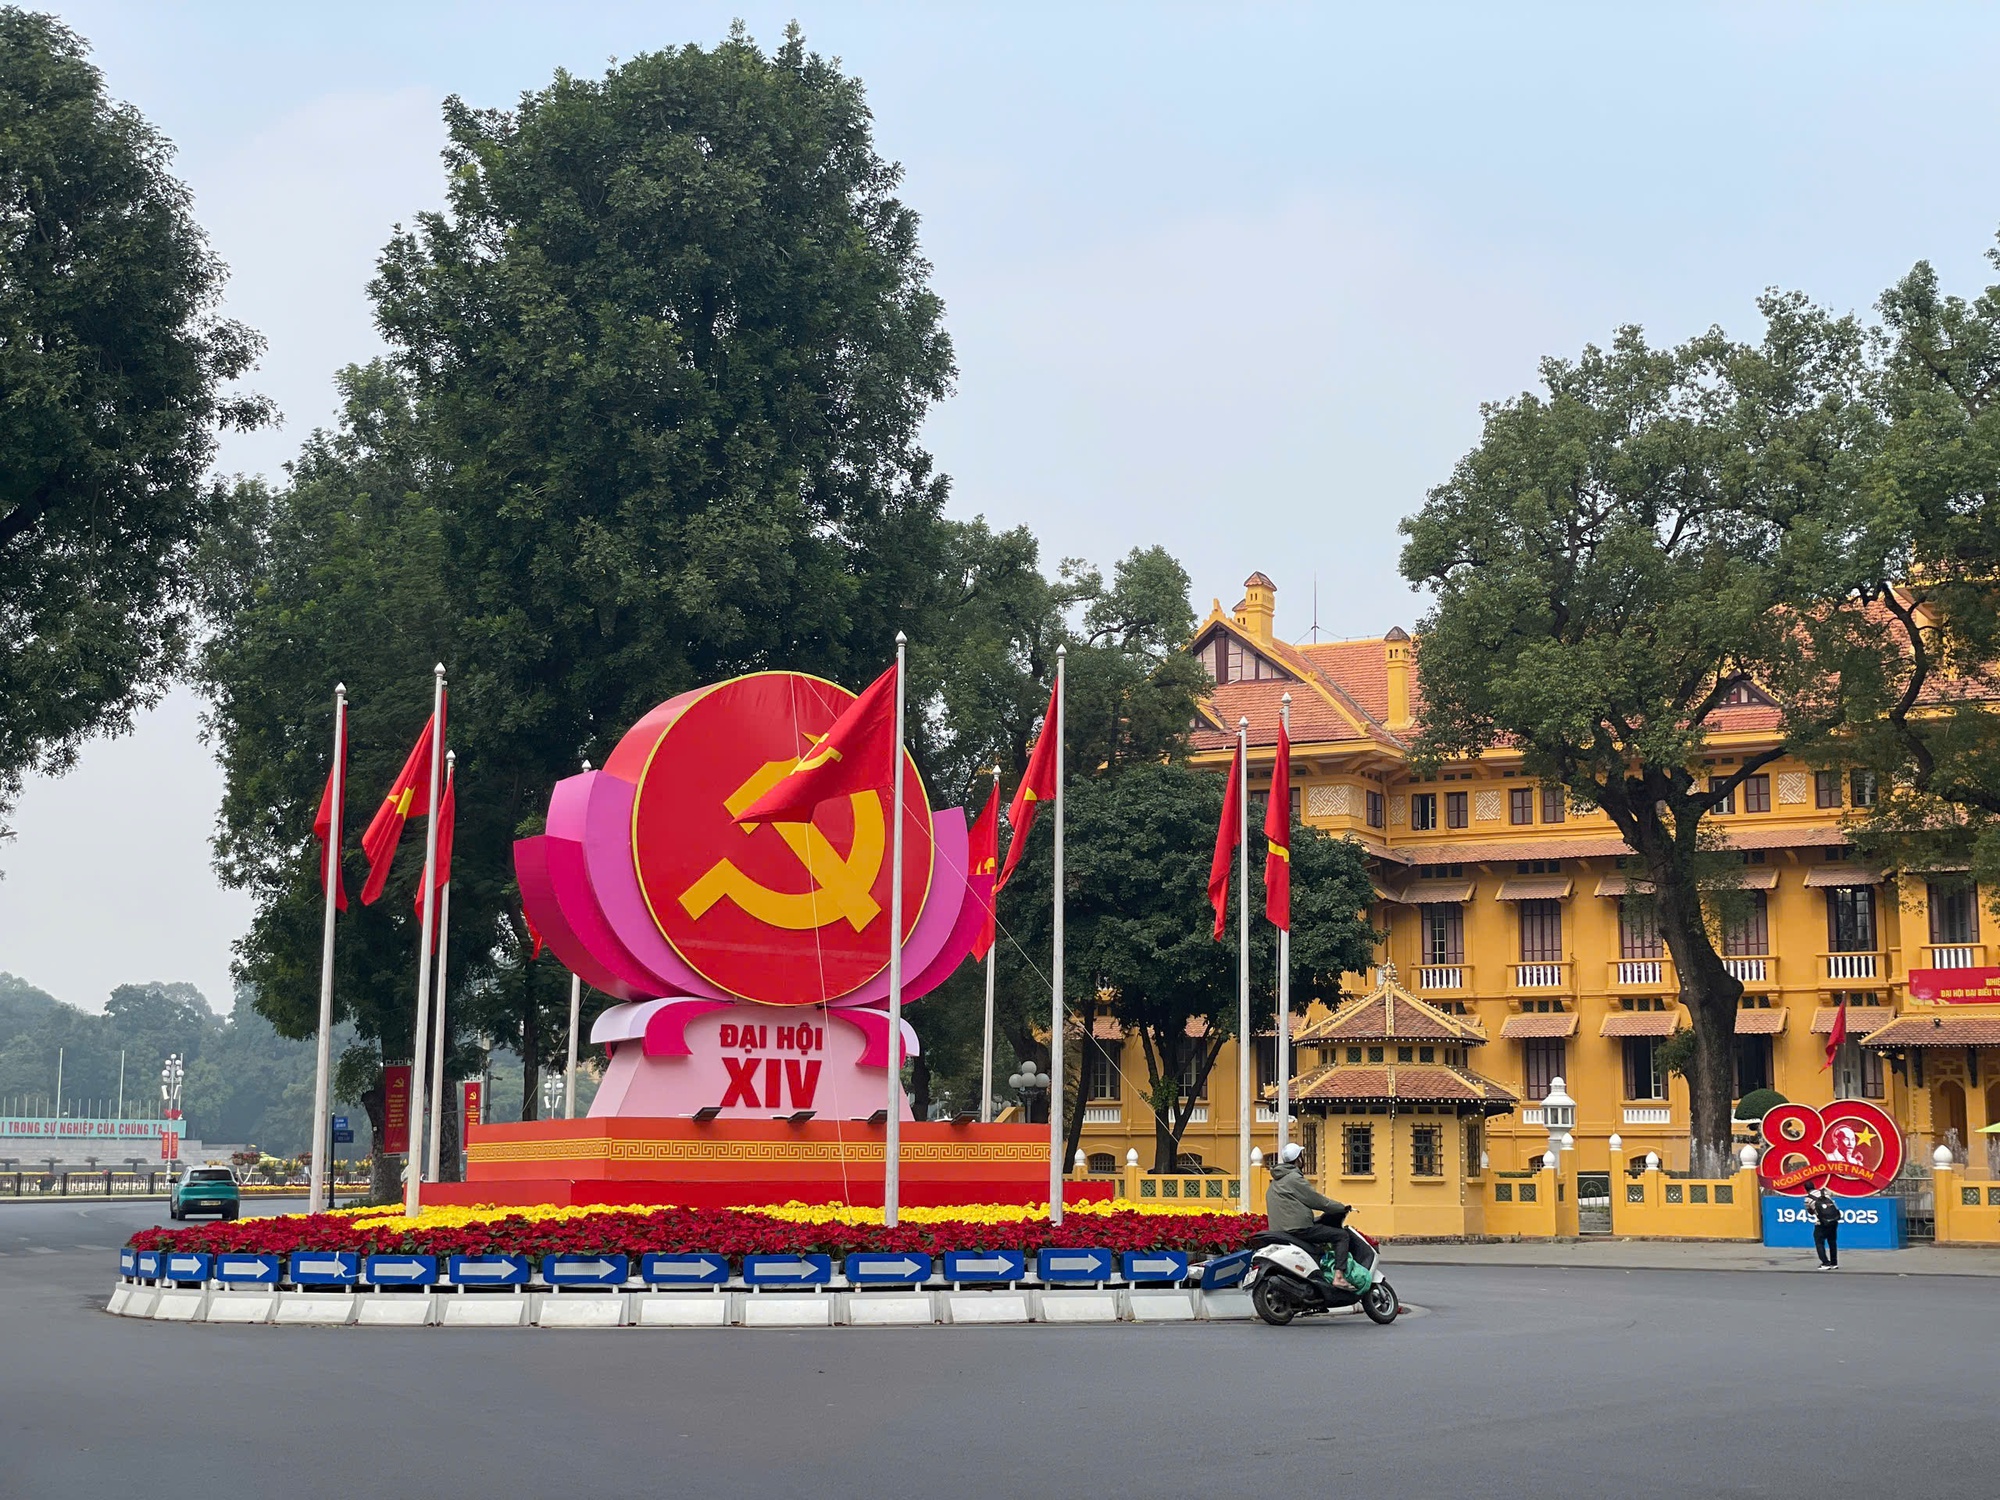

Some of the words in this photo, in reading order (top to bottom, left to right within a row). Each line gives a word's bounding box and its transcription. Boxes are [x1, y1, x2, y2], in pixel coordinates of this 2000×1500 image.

[719, 1024, 767, 1054] ĐẠI
[776, 1022, 823, 1055] HỘI
[719, 1057, 822, 1109] XIV
[9, 1121, 40, 1134] TRONG
[44, 1121, 57, 1136] SỰ
[60, 1120, 94, 1136] NGHIỆP
[97, 1120, 115, 1134] CỦA
[119, 1121, 149, 1135] CHÚNG
[152, 1123, 163, 1135] TA
[1760, 1098, 1903, 1198] 80
[1772, 1172, 1803, 1187] NGOẠI
[1803, 1164, 1826, 1177] GIAO
[1827, 1162, 1850, 1173] VIỆT
[1850, 1167, 1875, 1180] NAM
[1777, 1208, 1818, 1223] 1945
